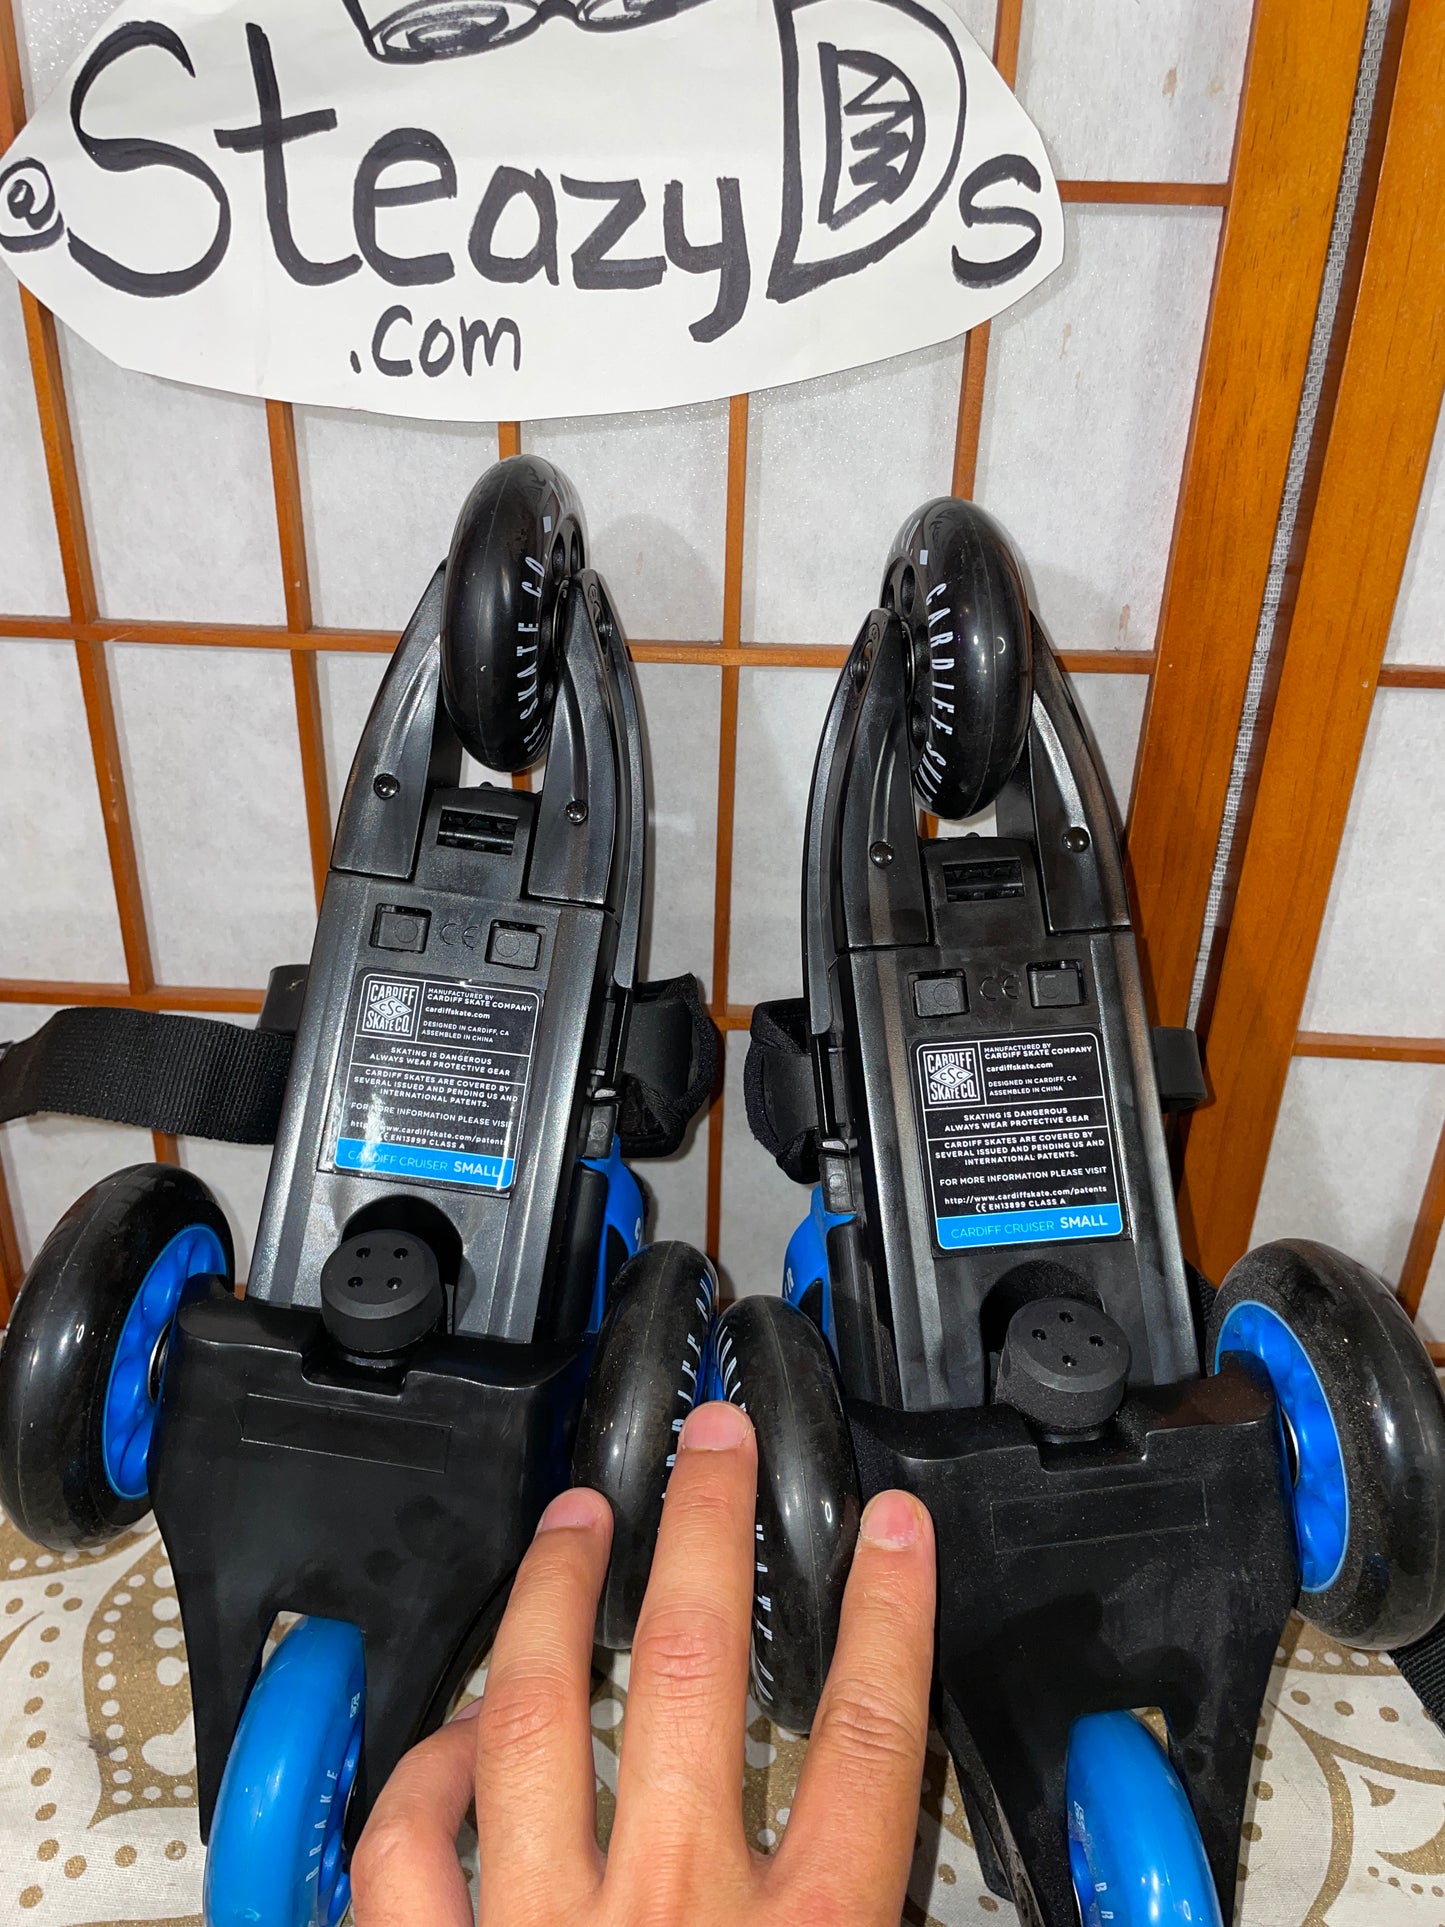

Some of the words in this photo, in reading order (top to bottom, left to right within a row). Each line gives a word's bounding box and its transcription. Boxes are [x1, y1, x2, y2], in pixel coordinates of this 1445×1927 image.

[349, 305, 522, 377] .com
[925, 583, 955, 736] CARDIFF
[370, 984, 416, 1006] CARDIFF
[426, 993, 463, 1003] CARDIFF
[464, 998, 490, 1007] SKATE
[491, 1001, 532, 1011] COMPANY
[427, 987, 483, 999] MANUFACTURED
[366, 1010, 394, 1031] SKATE
[395, 1015, 410, 1033] CO.
[424, 1005, 490, 1019] cardiffskate.com
[421, 1029, 462, 1039] ASSEMBLED
[422, 1020, 457, 1030] DESIGNED
[467, 1025, 498, 1035] CARDIFF,
[390, 1046, 427, 1057] SKATING
[439, 1052, 492, 1065] DANGEROUS
[983, 1043, 1040, 1053] MANUFACTURED
[984, 1051, 1021, 1059] CARDIFF
[1022, 1048, 1049, 1057] SKATE
[1051, 1045, 1092, 1054] COMPANY
[369, 1053, 404, 1063] ALWAYS
[405, 1057, 431, 1066] WEAR
[433, 1060, 485, 1073] PROTECTIVE
[486, 1067, 510, 1076] GEAR
[927, 1051, 972, 1073] CARDIFF
[985, 1061, 1053, 1072] cardiffskate.com
[353, 1076, 392, 1086] SEVERAL
[393, 1081, 424, 1090] ISSUED
[426, 1085, 448, 1093] AND
[448, 1087, 485, 1098] PENDING
[499, 1094, 518, 1102] AND
[365, 1068, 402, 1079] CARDIFF
[403, 1073, 435, 1083] SKATES
[437, 1077, 454, 1085] ARE
[456, 1079, 497, 1091] COVERED
[988, 1078, 1023, 1087] DESIGNED
[1033, 1076, 1065, 1084] CARDIFF,
[379, 1088, 448, 1102] INTERNATIONAL
[449, 1096, 489, 1107] PATENTS.
[930, 1081, 960, 1100] SKATE
[960, 1080, 977, 1098] CO.
[989, 1087, 1030, 1096] ASSEMBLED
[350, 1102, 369, 1110] FOR
[396, 1107, 456, 1121] INFORMATION
[457, 1115, 490, 1125] PLEASE
[944, 1122, 980, 1132] ALWAYS
[981, 1120, 1007, 1129] WEAR
[1010, 1116, 1063, 1127] PROTECTIVE
[1065, 1114, 1089, 1122] GEAR
[963, 1112, 1001, 1121] SKATING
[1013, 1106, 1067, 1117] DANGEROUS
[390, 1134, 426, 1144] EN13899
[428, 1138, 456, 1148] CLASS
[935, 1149, 974, 1159] SEVERAL
[976, 1146, 1008, 1155] ISSUED
[1010, 1144, 1032, 1153] AND
[1032, 1141, 1070, 1151] PENDING
[1085, 1139, 1104, 1147] AND
[944, 1139, 982, 1149] CARDIFF
[984, 1136, 1017, 1146] SKATES
[1019, 1135, 1036, 1143] ARE
[1038, 1131, 1080, 1142] COVERED
[400, 1156, 448, 1171] CRUISER
[453, 1161, 499, 1178] SMALL
[964, 1153, 1035, 1166] INTERNATIONAL
[1037, 1150, 1078, 1160] PATENTS.
[939, 1178, 957, 1186] FOR
[959, 1175, 985, 1185] MORE
[987, 1170, 1048, 1182] INFORMATION
[1050, 1168, 1083, 1178] PLEASE
[1084, 1166, 1107, 1175] VISIT
[988, 1200, 1026, 1210] EN13899
[1028, 1198, 1057, 1207] CLASS
[951, 1225, 1001, 1239] CARDIFF
[1004, 1221, 1055, 1234] CRUISER
[1060, 1215, 1109, 1229] SMALL
[305, 1769, 338, 1882] BRAKE
